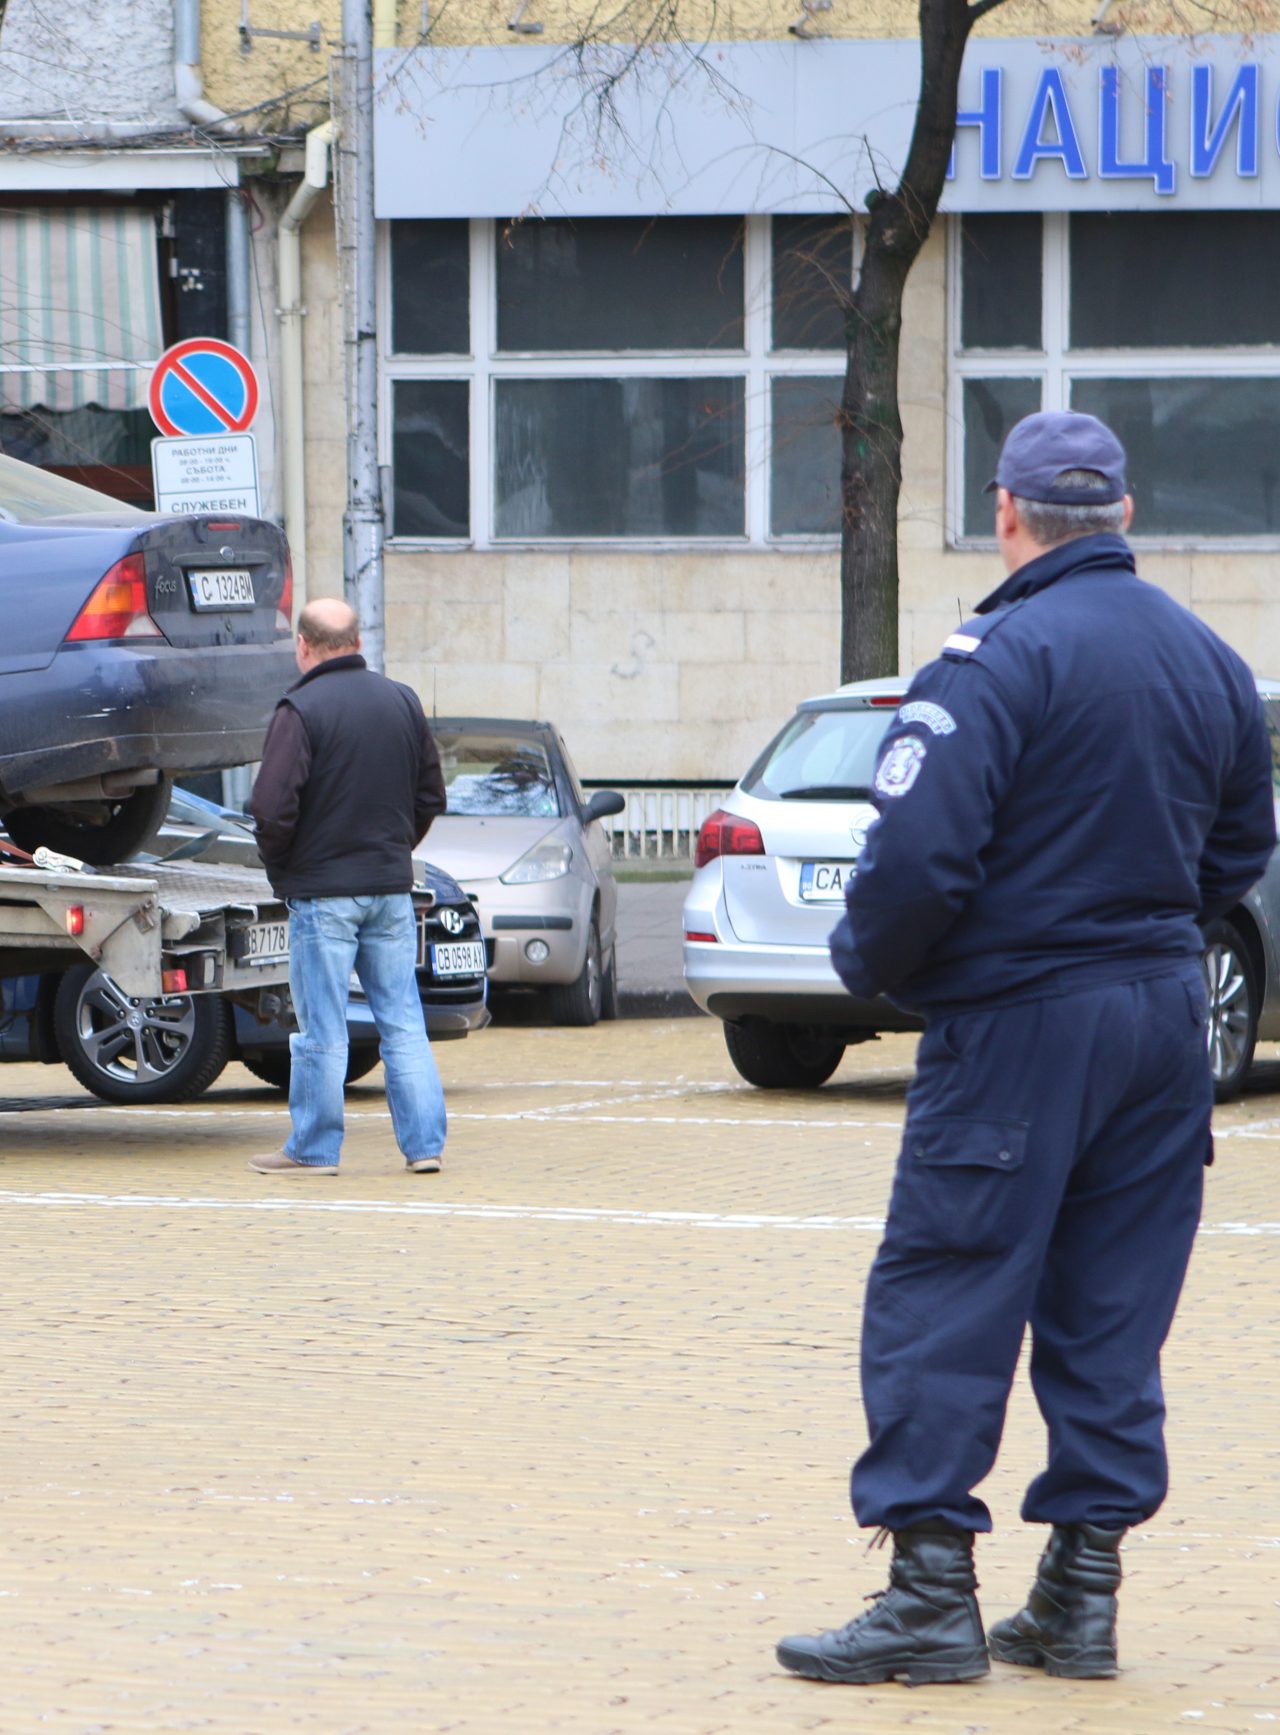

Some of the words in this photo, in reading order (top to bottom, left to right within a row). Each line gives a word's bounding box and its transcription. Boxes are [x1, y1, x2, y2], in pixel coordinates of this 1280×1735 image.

[946, 64, 1280, 195] НАЦИ
[171, 447, 216, 457] РАБОТНИ
[218, 445, 238, 455] ДНИ
[186, 465, 226, 475] СЪБОТА
[171, 499, 247, 513] СЛУЖЕБЕН
